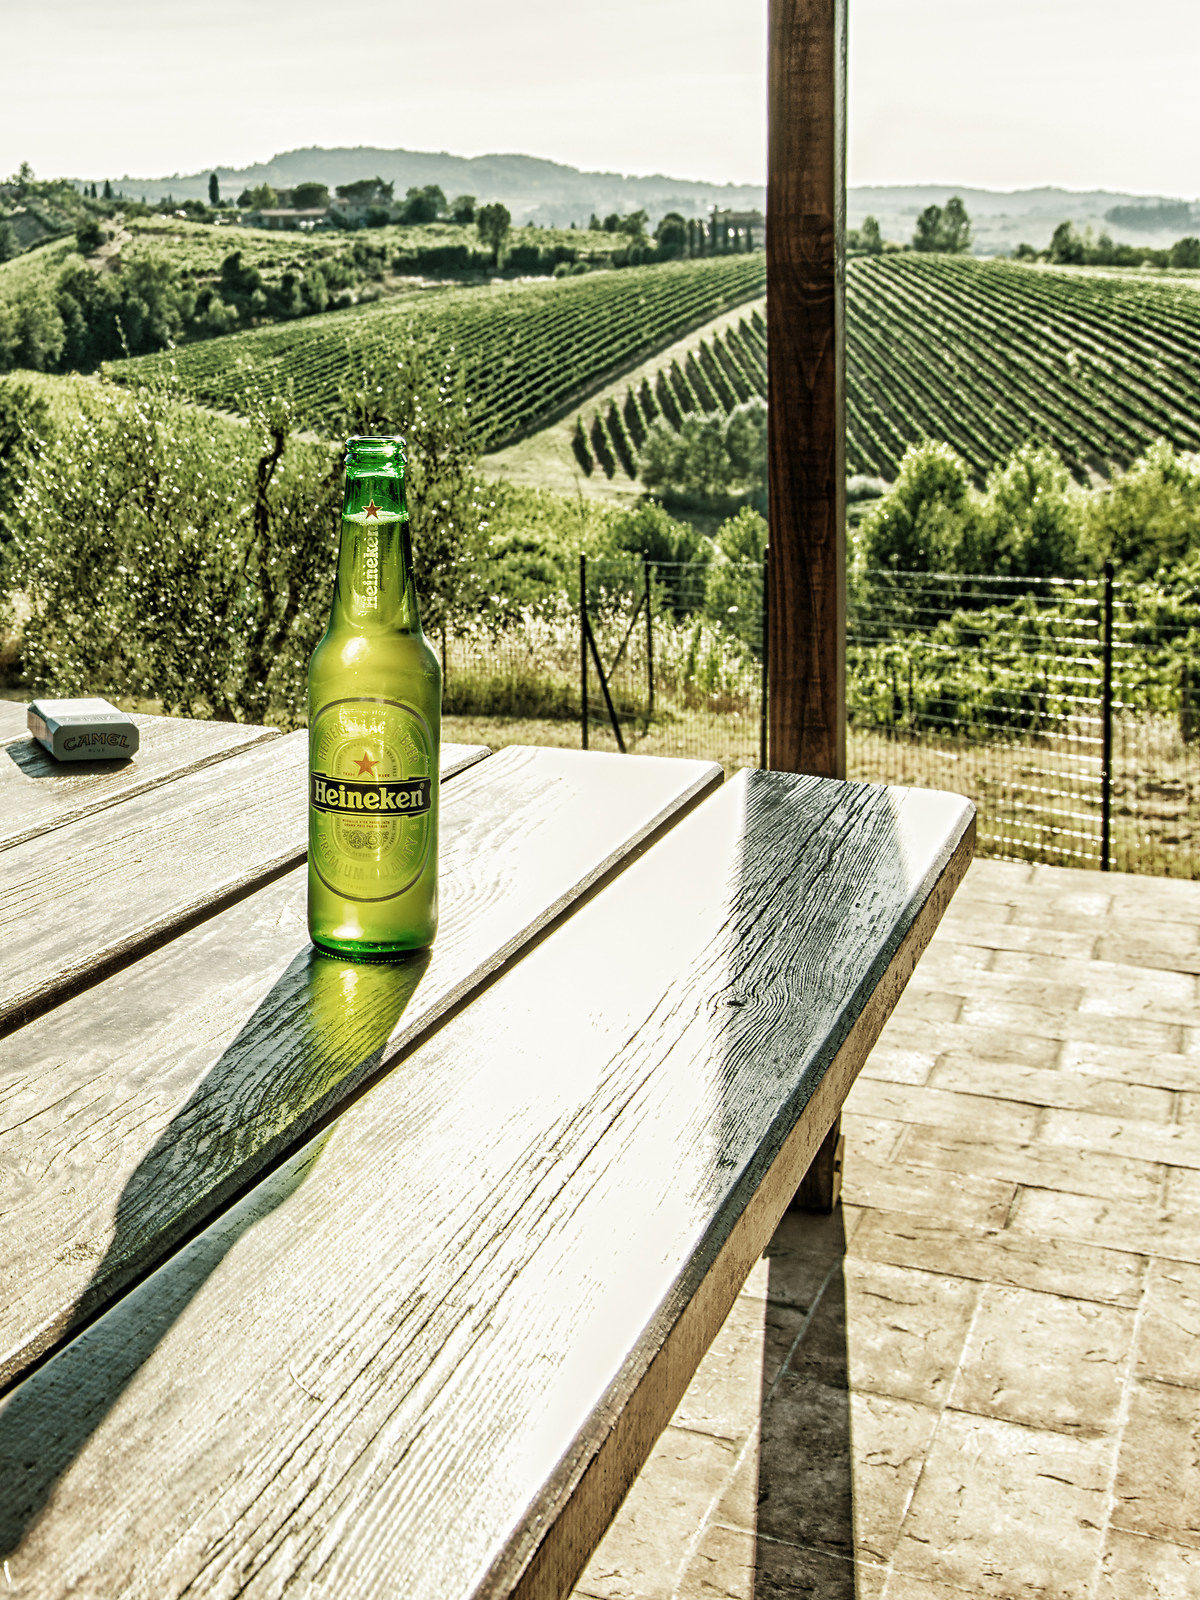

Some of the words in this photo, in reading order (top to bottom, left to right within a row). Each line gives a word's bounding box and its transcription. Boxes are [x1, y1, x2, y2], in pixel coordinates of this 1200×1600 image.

[363, 524, 379, 609] Heineken
[63, 732, 130, 751] CAMEL
[318, 832, 365, 881] PREMIUM
